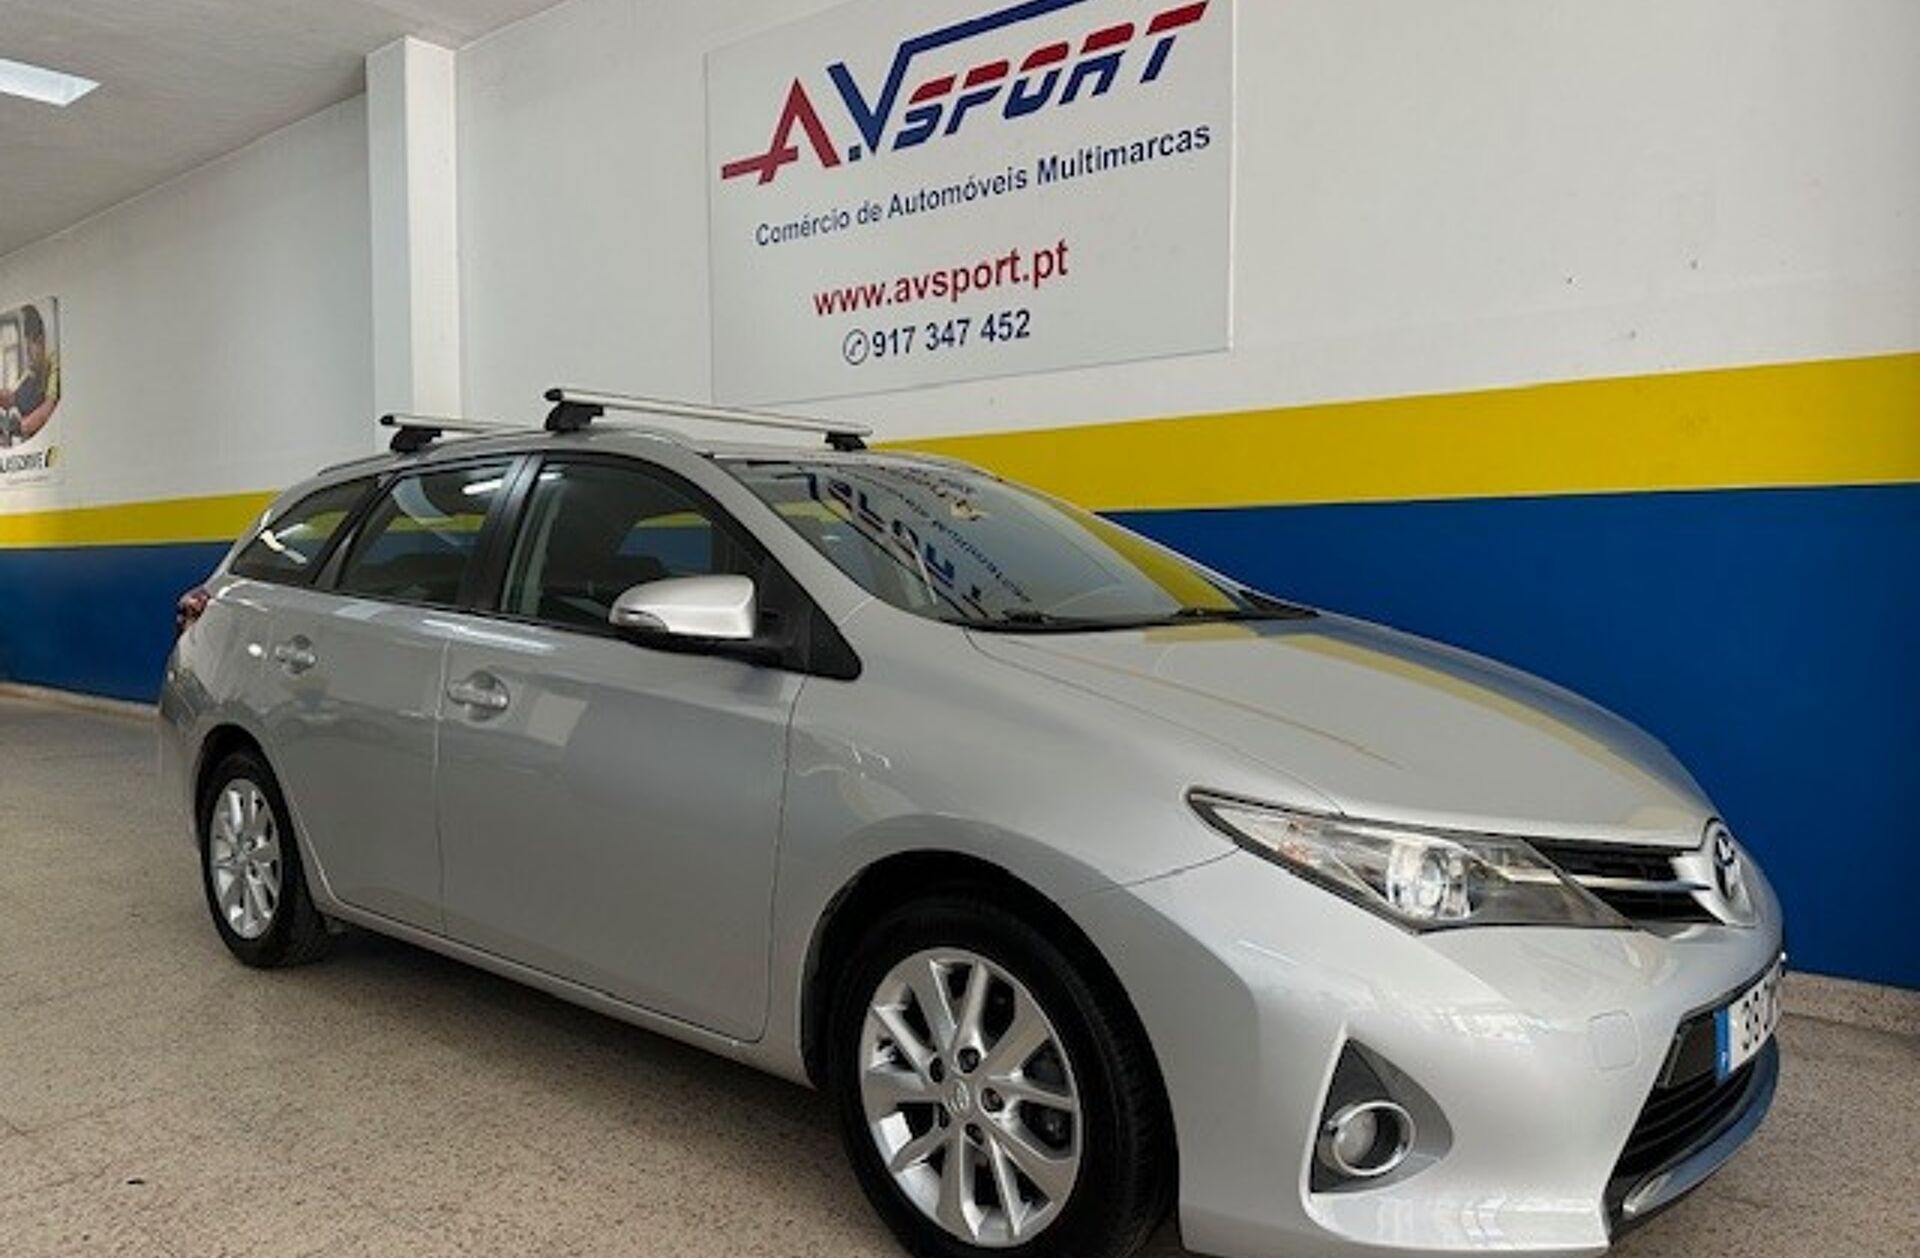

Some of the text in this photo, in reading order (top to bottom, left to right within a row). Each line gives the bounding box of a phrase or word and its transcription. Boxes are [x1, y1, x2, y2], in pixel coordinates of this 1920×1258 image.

[756, 125, 1211, 246] Comércio de Automóveis Multimarcas
[813, 239, 1069, 316] www.avsport.pt
[872, 309, 1030, 358] 917 347 452
